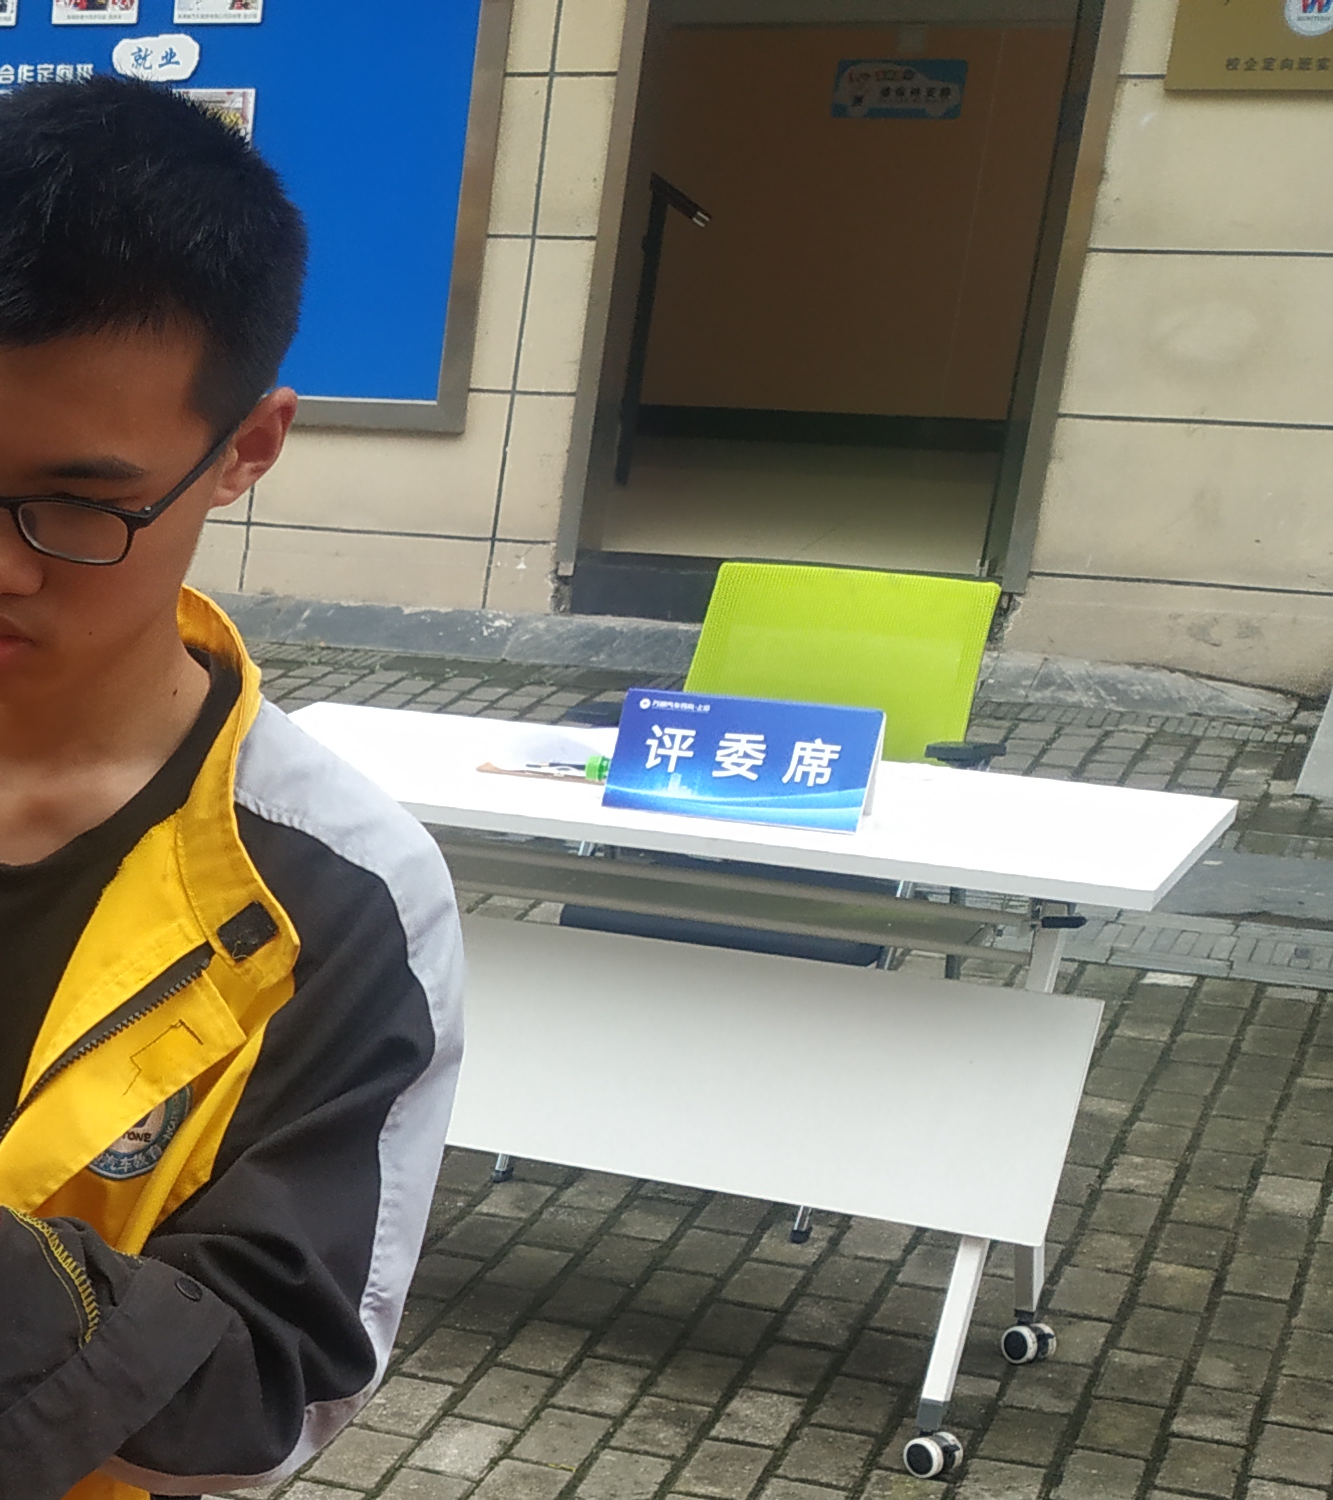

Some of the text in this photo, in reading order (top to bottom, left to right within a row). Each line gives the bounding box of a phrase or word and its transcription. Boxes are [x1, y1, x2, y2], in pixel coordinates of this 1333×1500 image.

[130, 47, 181, 71] 就业
[644, 724, 842, 787] 评委席
